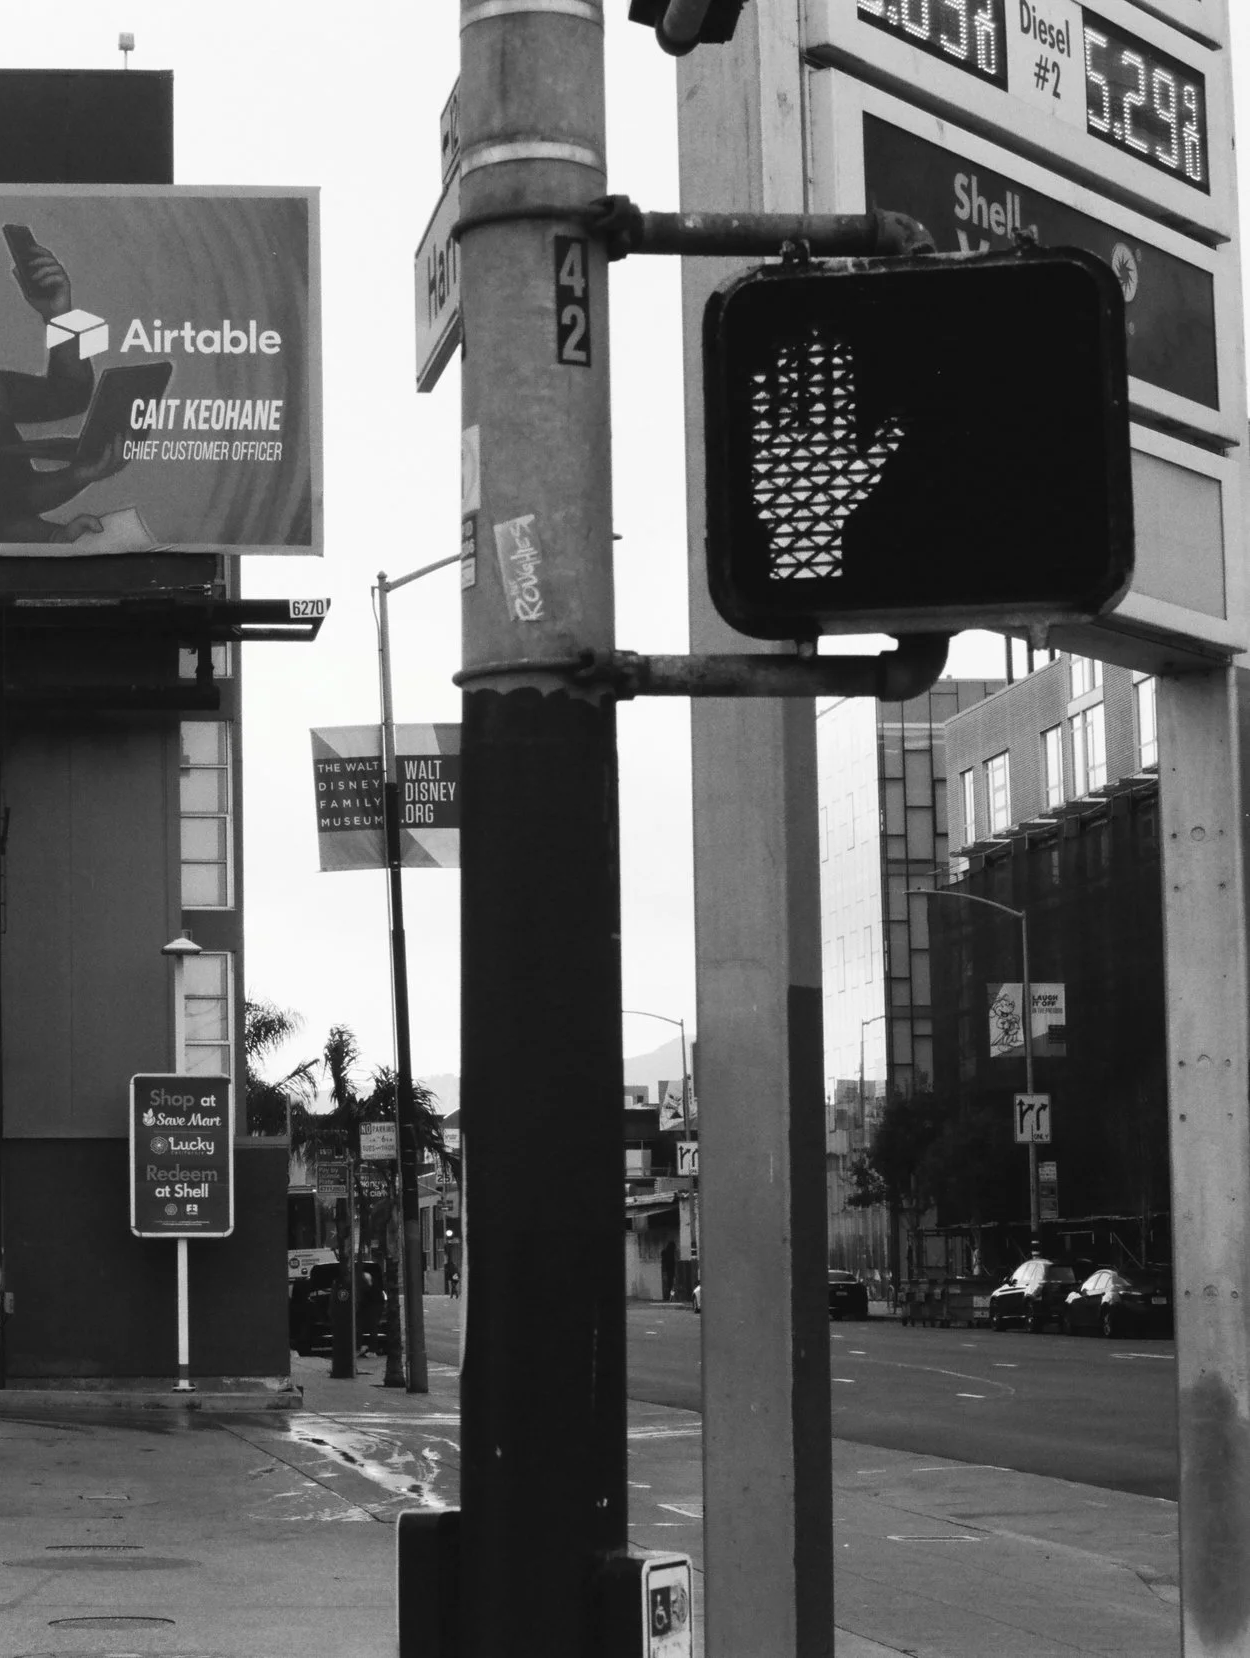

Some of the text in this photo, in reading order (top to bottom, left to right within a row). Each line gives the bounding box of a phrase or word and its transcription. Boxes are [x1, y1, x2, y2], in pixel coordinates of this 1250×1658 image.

[1020, 0, 1071, 58] Diesel
[1033, 54, 1062, 100] #2
[953, 172, 1021, 240] Shell
[120, 319, 282, 354] Airtable
[130, 398, 283, 431] CAIT KEOHANE
[123, 440, 283, 461] CHIEF CUSTOMER OFFICER
[292, 599, 324, 617] 6270
[318, 761, 379, 773] THE WALT
[405, 760, 442, 780] WALT
[318, 780, 380, 791] DISNEY
[405, 782, 456, 802] DISNEY
[320, 798, 381, 809] FAMILY
[321, 816, 383, 828] MUSEUM
[401, 803, 434, 824] .ORG
[149, 1088, 216, 1111] Shop at
[156, 1112, 222, 1127] Save Mart
[361, 1124, 371, 1134] NO
[168, 1136, 215, 1155] Lucky
[146, 1164, 218, 1182] Redeem
[155, 1183, 209, 1198] at Shell
